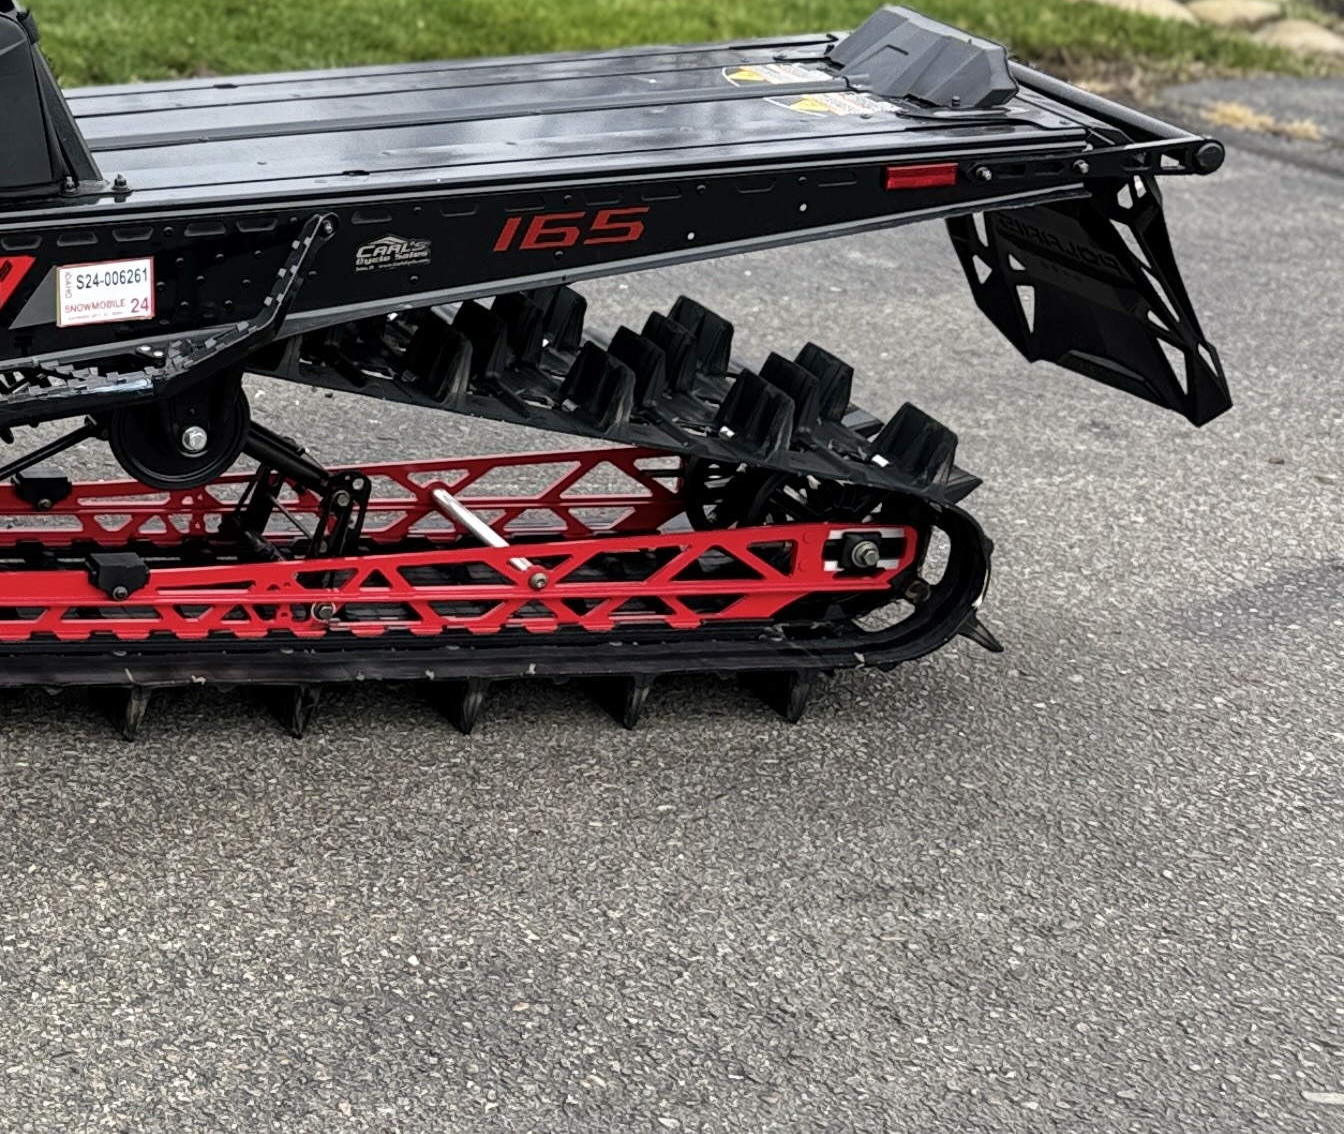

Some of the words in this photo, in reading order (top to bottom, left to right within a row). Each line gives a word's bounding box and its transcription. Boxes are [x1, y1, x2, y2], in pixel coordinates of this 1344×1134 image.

[493, 207, 652, 253] 165
[76, 267, 148, 290] S24-006261
[64, 299, 126, 313] SNOWMOBILE
[130, 297, 149, 313] 24
